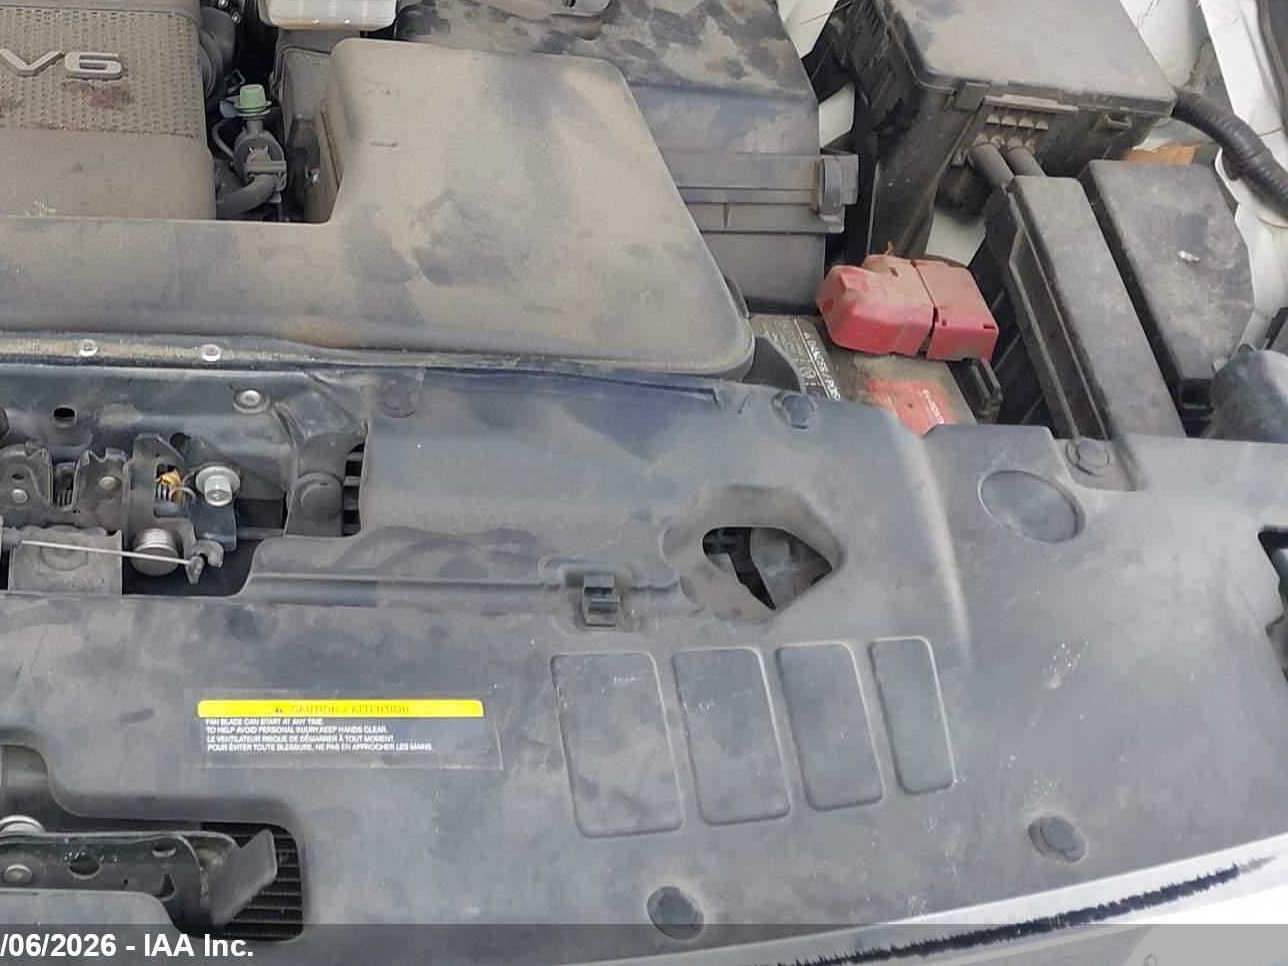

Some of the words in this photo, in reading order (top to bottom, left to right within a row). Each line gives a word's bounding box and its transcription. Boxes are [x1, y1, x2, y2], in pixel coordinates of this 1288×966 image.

[292, 705, 338, 714] CAUTION
[352, 705, 410, 715] ATTENTION
[206, 725, 216, 734] TO
[217, 725, 236, 734] HELP
[236, 725, 258, 734] AVOID
[258, 725, 295, 734] PERSONAL
[338, 725, 363, 734] HANDS
[207, 734, 216, 743] LE
[216, 734, 261, 743] VENTILATEUR
[262, 734, 288, 743] RISQUE
[289, 734, 299, 743] DE
[344, 734, 363, 743] TOUT
[207, 743, 228, 752] POUR
[253, 743, 276, 752] TOUTE
[315, 743, 325, 752] NE
[326, 743, 340, 752] PAS
[341, 743, 351, 752] EN
[352, 743, 395, 752] APPROCHER
[395, 743, 409, 752] LES
